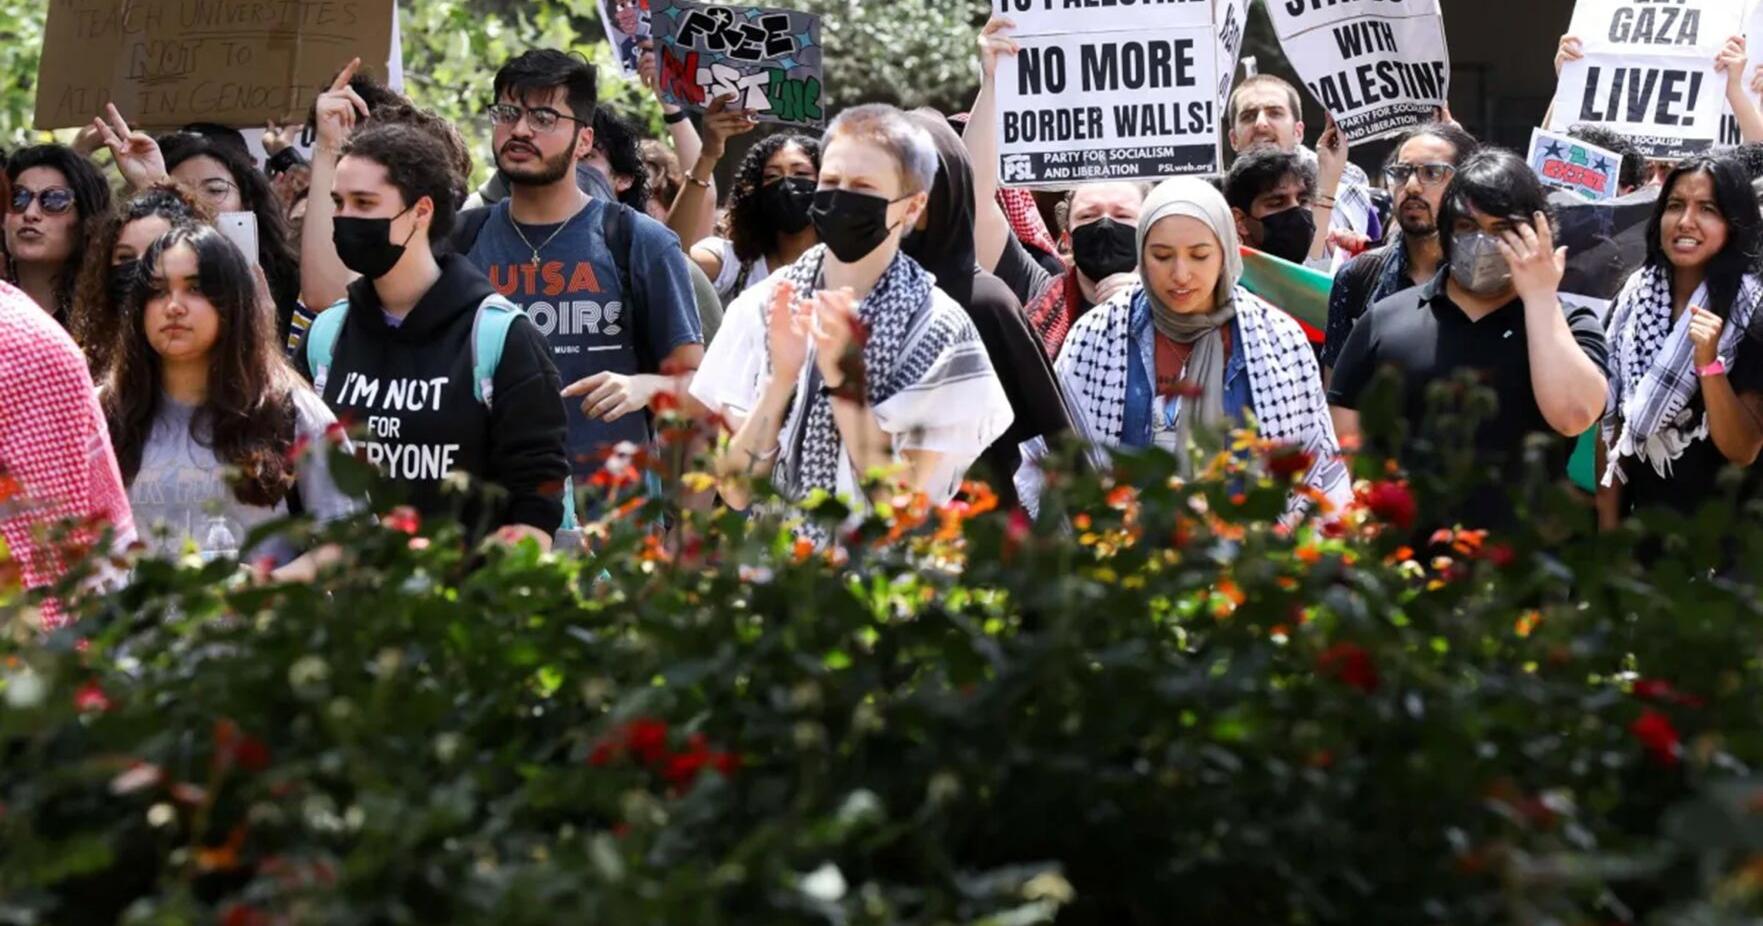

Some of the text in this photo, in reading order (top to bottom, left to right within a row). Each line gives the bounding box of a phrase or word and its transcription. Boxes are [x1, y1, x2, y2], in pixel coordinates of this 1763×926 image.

[74, 5, 162, 38] TEACH
[675, 7, 795, 62] FREE
[1608, 6, 1701, 46] GAZA
[1333, 21, 1398, 60] WITH
[131, 39, 252, 78] NOT TO
[1018, 46, 1067, 96] NO
[1080, 39, 1197, 92] MORE
[138, 90, 178, 114] IN
[190, 81, 313, 114] GENOCI
[1579, 66, 1704, 127] LIVE!
[1003, 101, 1214, 144] BORDER WALLS!
[1340, 112, 1373, 129] PARTY
[1373, 108, 1391, 119] FOR
[1345, 115, 1418, 140] AND LIBERATION
[1043, 146, 1174, 165] PARTY FOR SOCIALISM
[1632, 134, 1683, 147] SOCIALISM
[1004, 159, 1037, 181] PSL
[1043, 163, 1139, 179] AND LIBERATION
[1157, 161, 1214, 174] PSLweb.org
[489, 260, 601, 296] UTSA
[515, 301, 623, 336] OIRS
[554, 345, 581, 354] MUSIC
[336, 372, 449, 411] I'M NOT
[368, 416, 400, 438] FOR
[356, 441, 460, 480] RYONE
